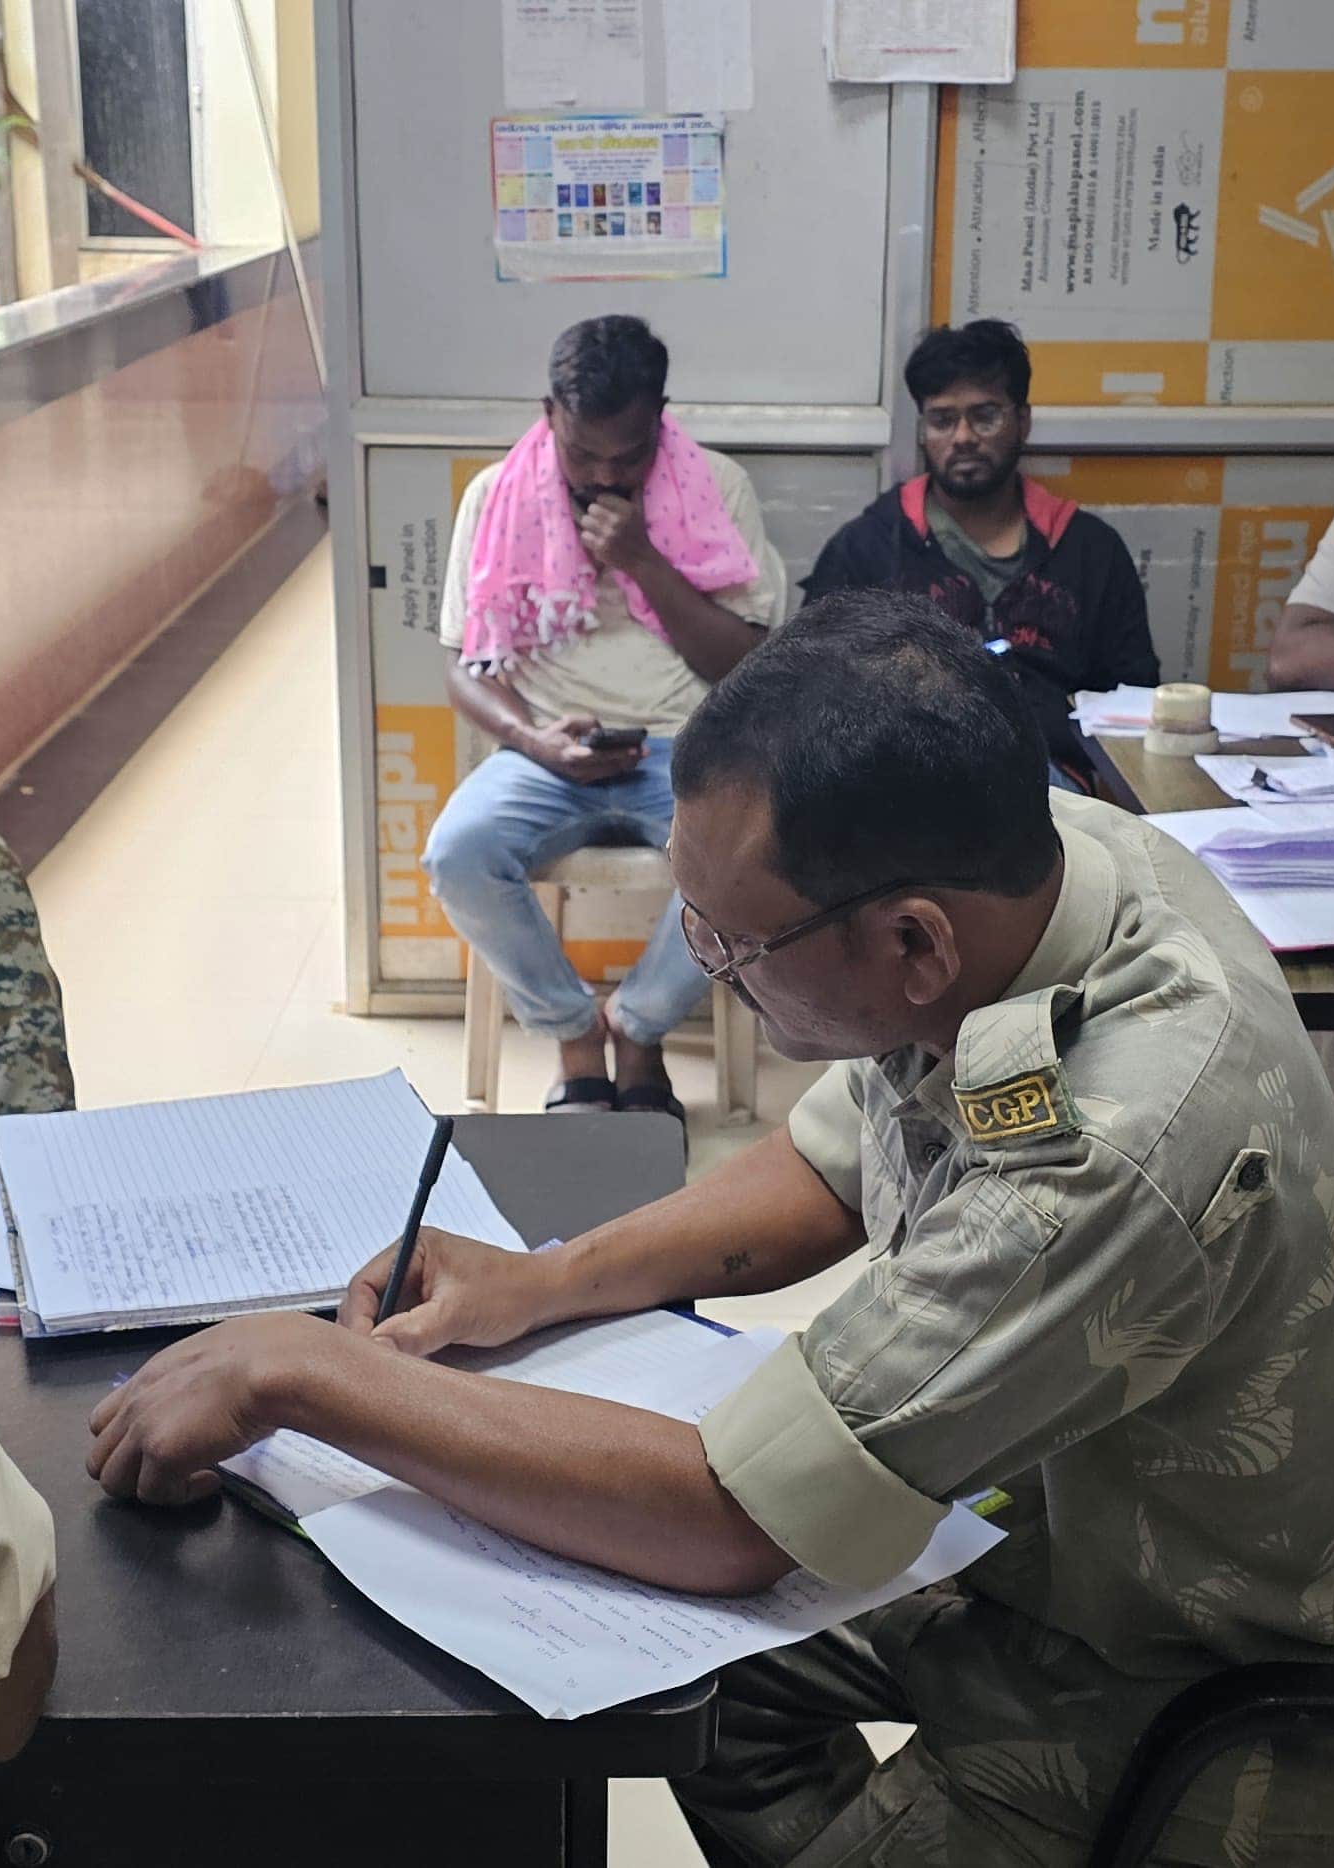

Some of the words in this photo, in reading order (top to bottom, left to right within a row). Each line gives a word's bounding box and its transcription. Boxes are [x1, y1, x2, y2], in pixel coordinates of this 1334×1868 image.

[1028, 102, 1040, 128] Ltd
[1151, 145, 1165, 187] India
[971, 161, 985, 232] Attraction
[1065, 91, 1085, 294] www.maplalupanel.com
[1149, 191, 1162, 205] in
[1148, 211, 1162, 251] Made
[1083, 243, 1093, 264] ISO
[967, 249, 981, 315] Attention
[400, 524, 414, 538] in
[401, 541, 415, 583] Panel
[422, 519, 437, 586] Direction
[401, 587, 419, 629] Apply
[424, 591, 438, 633] Arrow
[968, 1089, 1043, 1131] CGP
